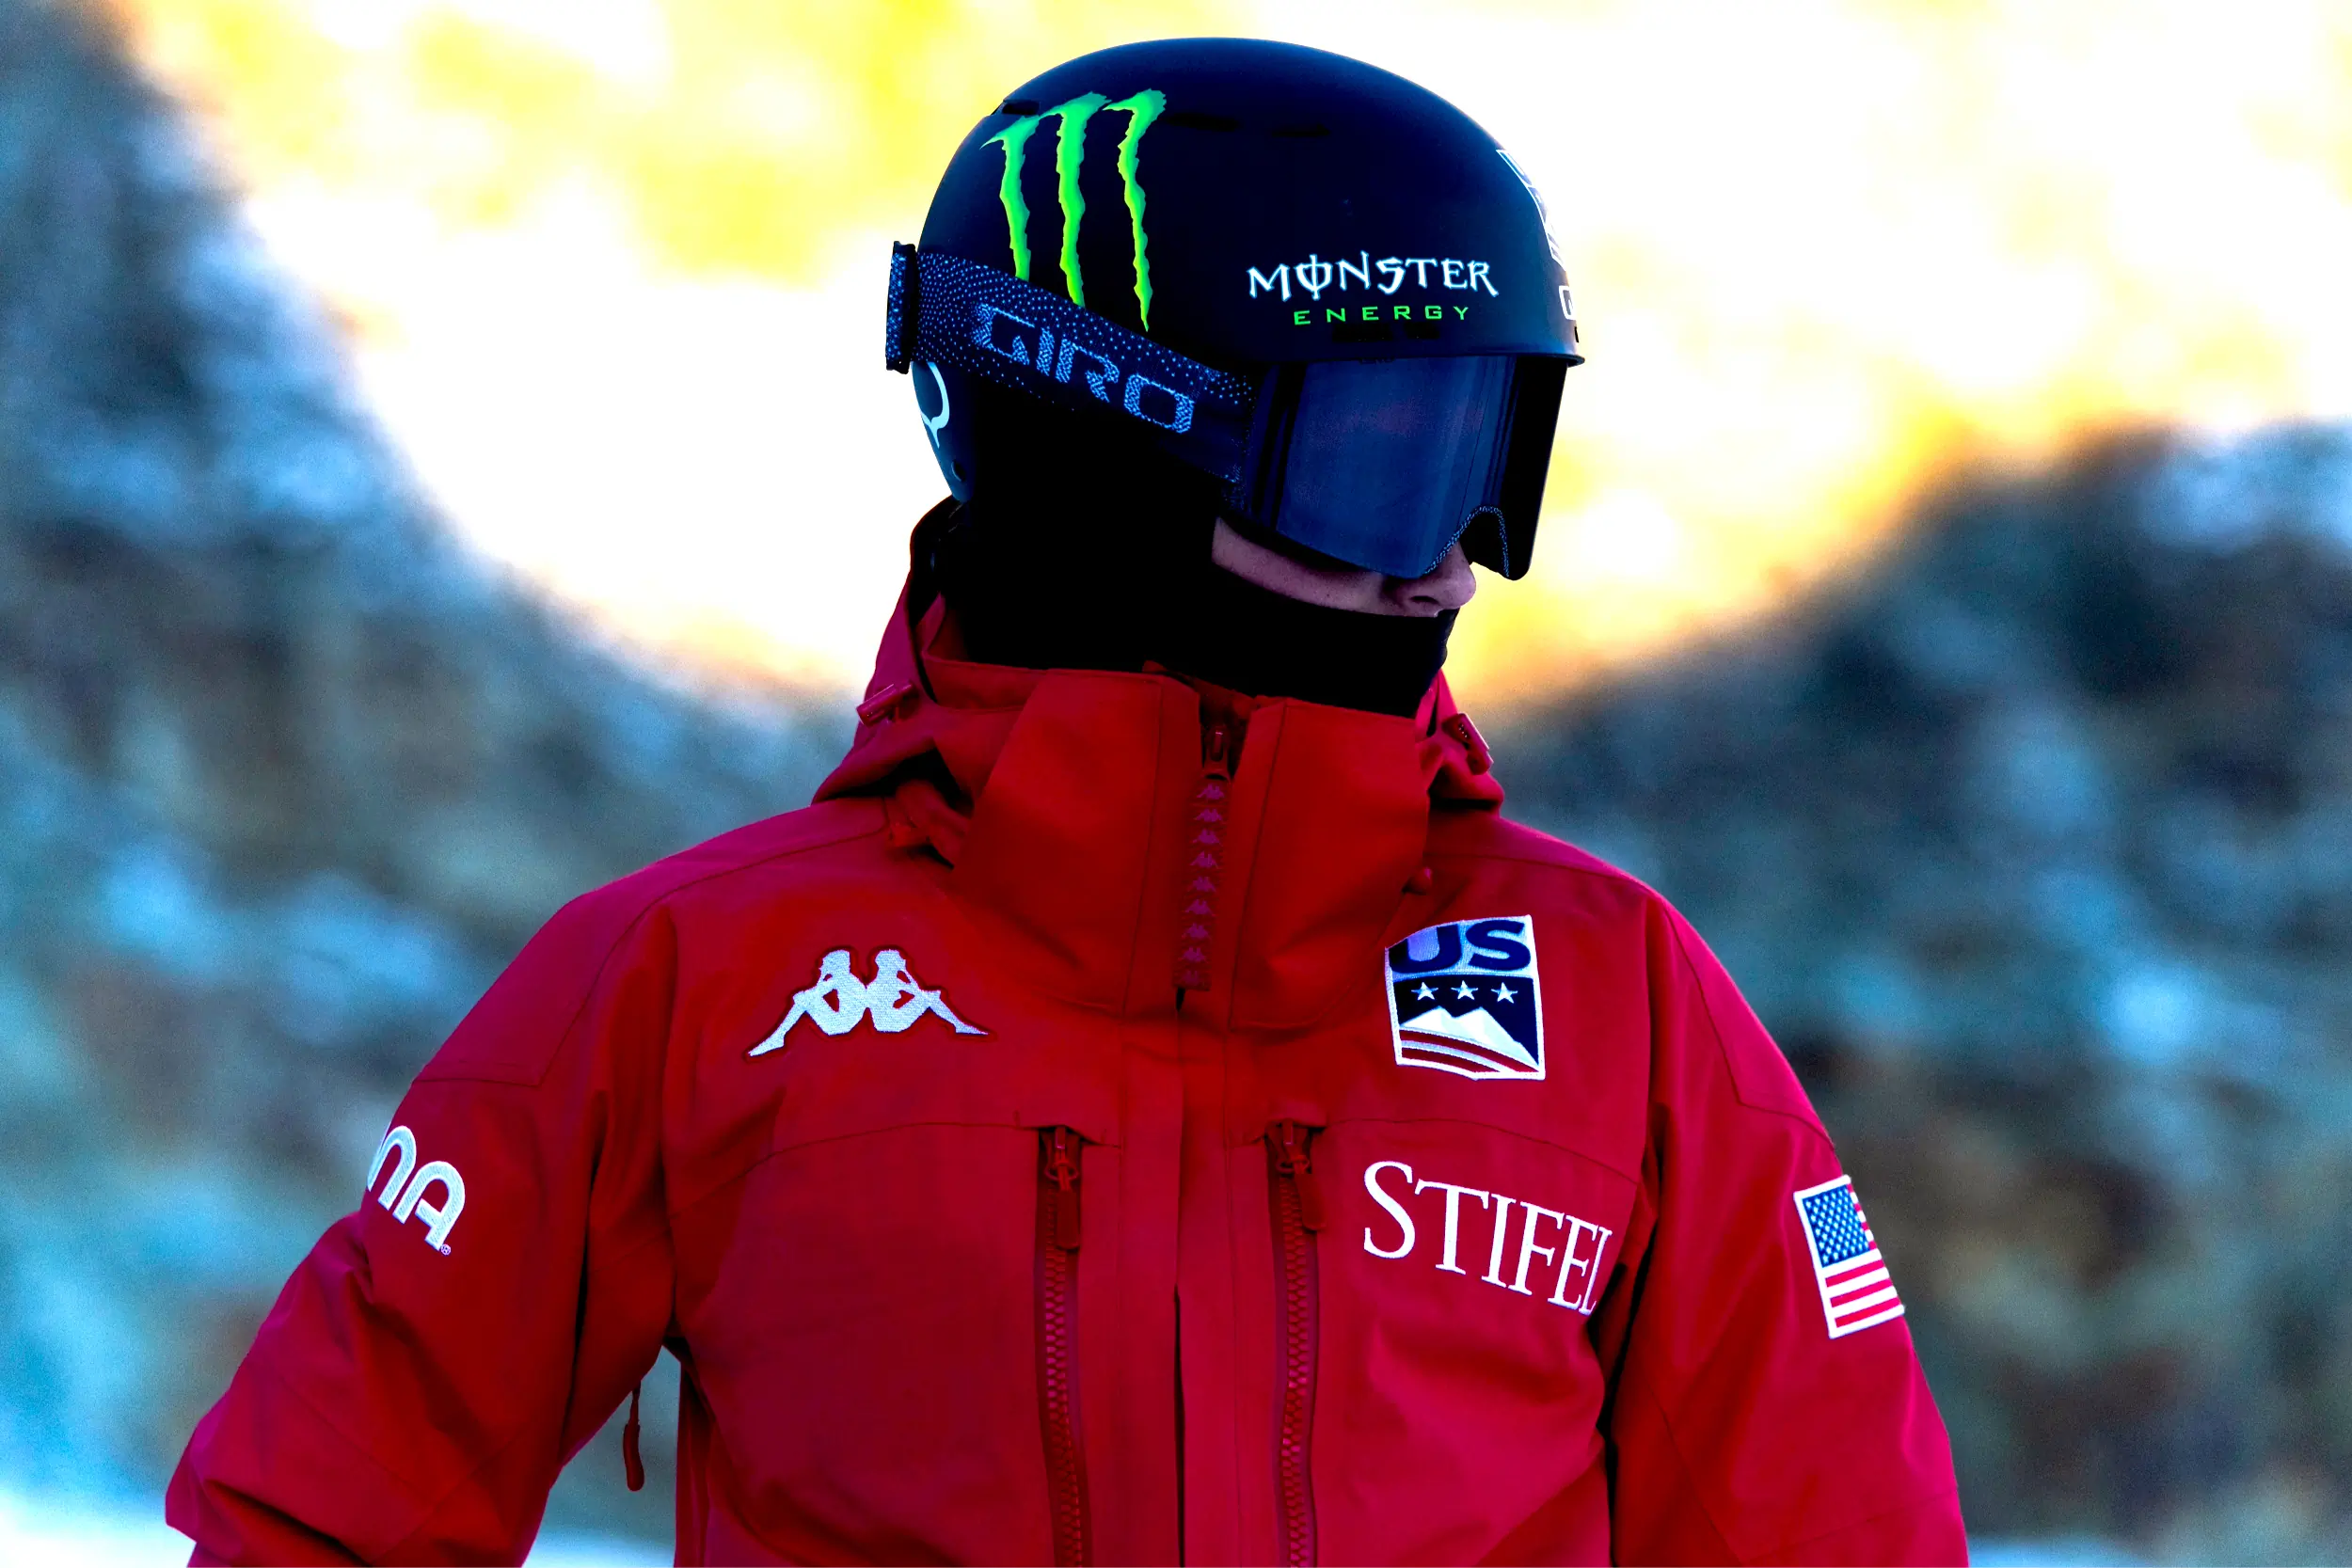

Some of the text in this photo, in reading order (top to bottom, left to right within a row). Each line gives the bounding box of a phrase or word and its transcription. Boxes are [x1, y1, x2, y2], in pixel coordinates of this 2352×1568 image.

[1247, 250, 1500, 302] MONSTER
[1294, 306, 1469, 325] ENERGY
[971, 303, 1195, 434] GIRO
[1389, 919, 1531, 974] US
[1363, 1161, 1613, 1316] STIFEL
